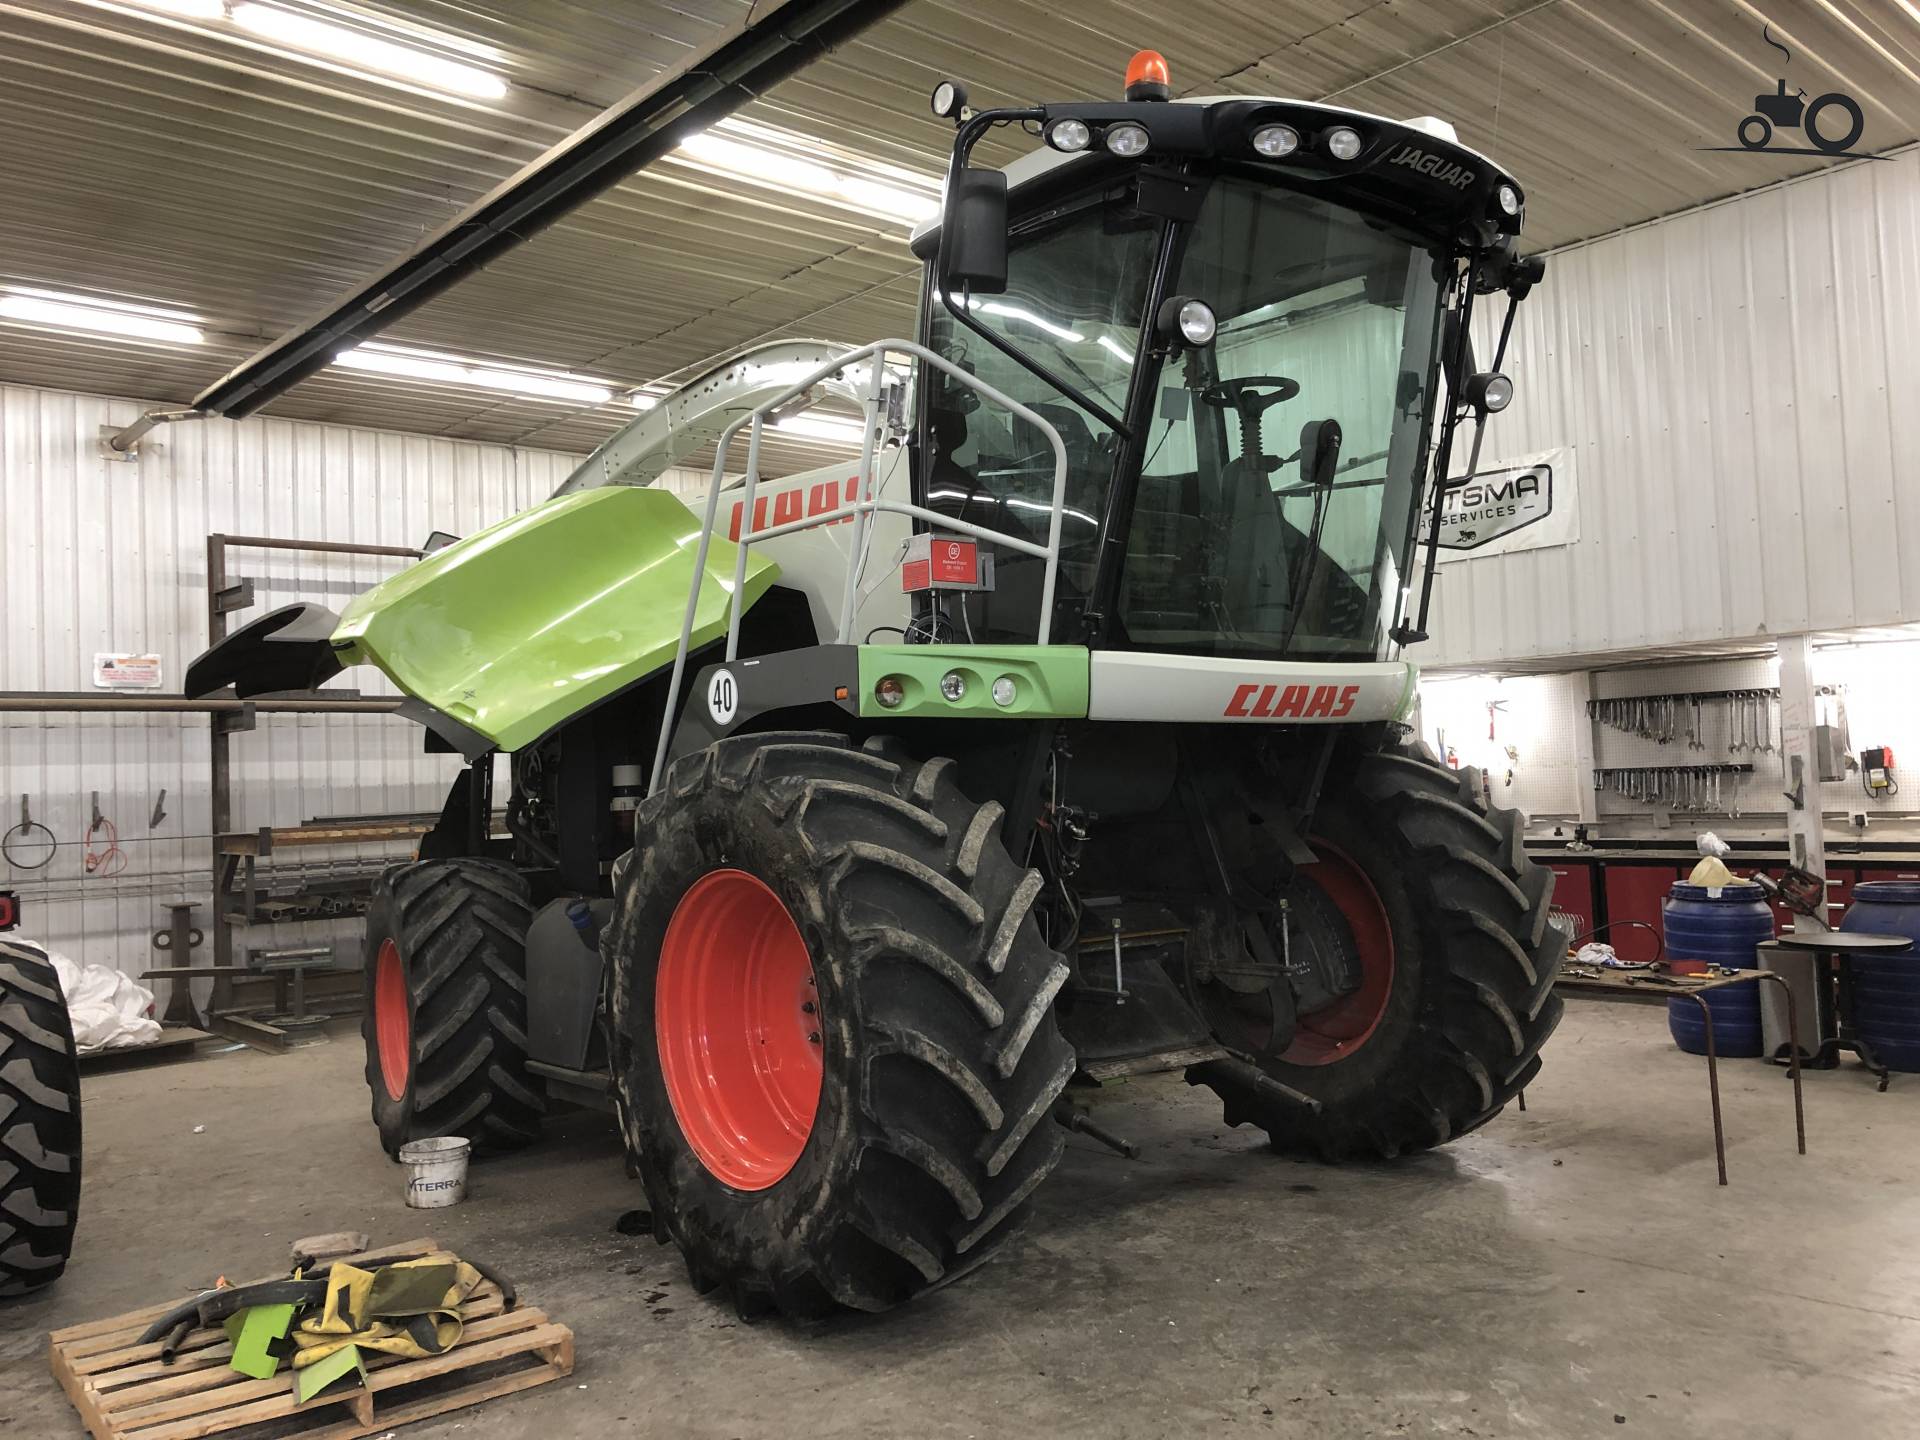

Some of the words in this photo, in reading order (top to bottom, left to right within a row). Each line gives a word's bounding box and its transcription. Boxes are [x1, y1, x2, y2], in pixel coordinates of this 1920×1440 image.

[1389, 146, 1476, 190] JAGUAR
[1440, 504, 1516, 526] SERVICES
[713, 677, 732, 713] 40
[1223, 684, 1361, 718] CLAAS
[408, 1177, 462, 1193] VITERRA
